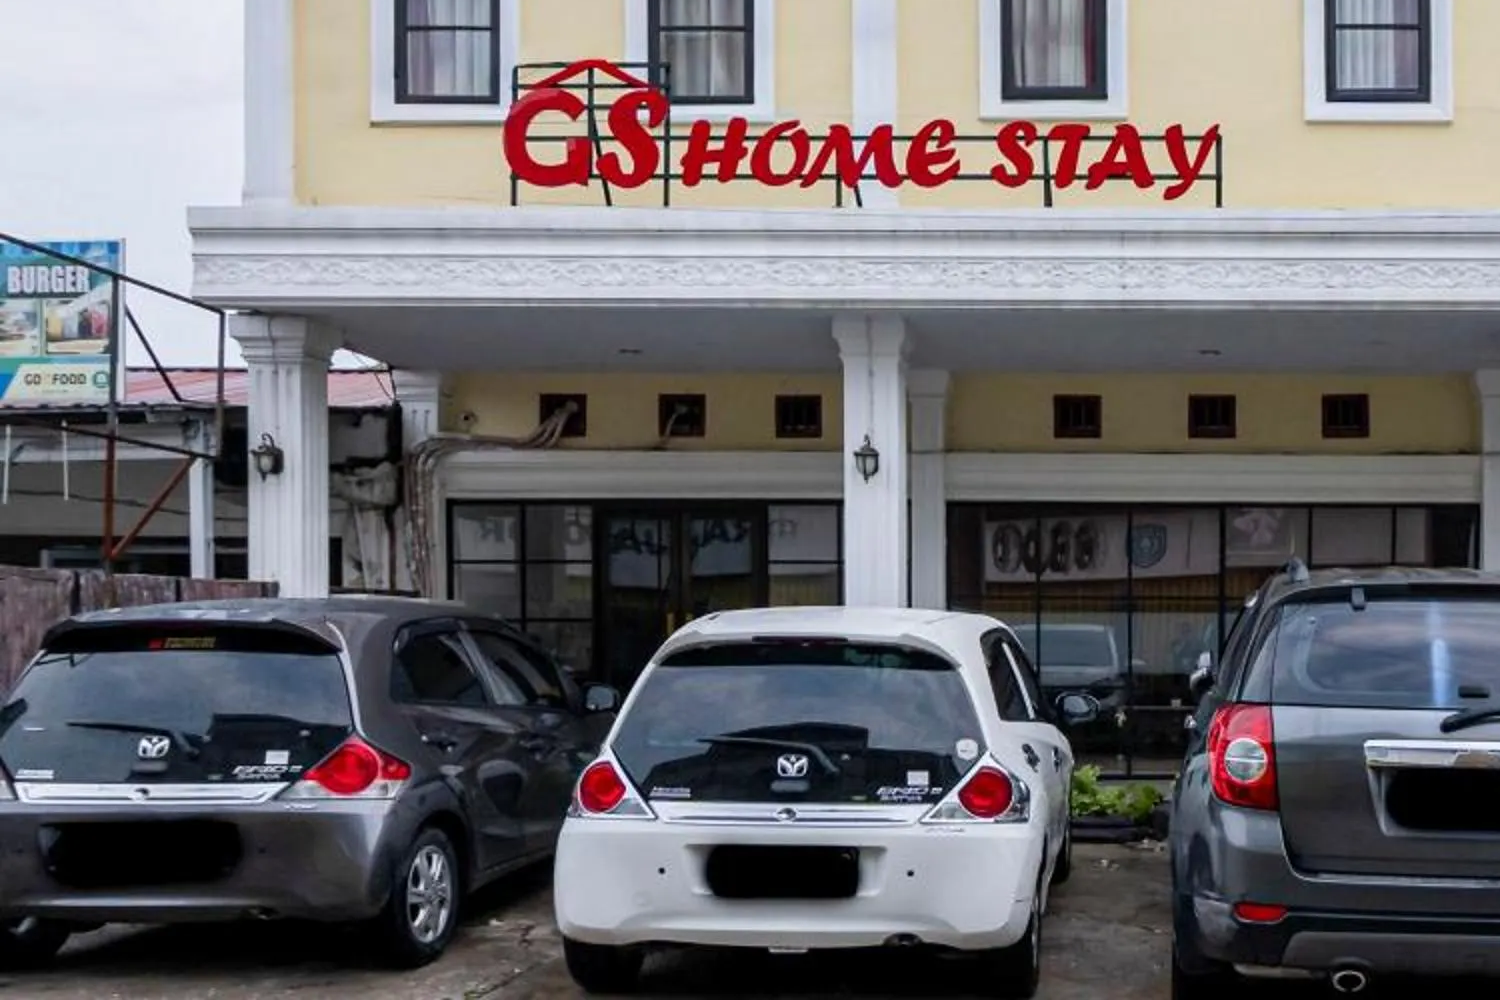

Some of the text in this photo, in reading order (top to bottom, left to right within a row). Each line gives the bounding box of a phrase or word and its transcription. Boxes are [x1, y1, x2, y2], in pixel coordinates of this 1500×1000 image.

[503, 86, 1219, 200] GS HOME STAY
[7, 265, 90, 295] BURGER
